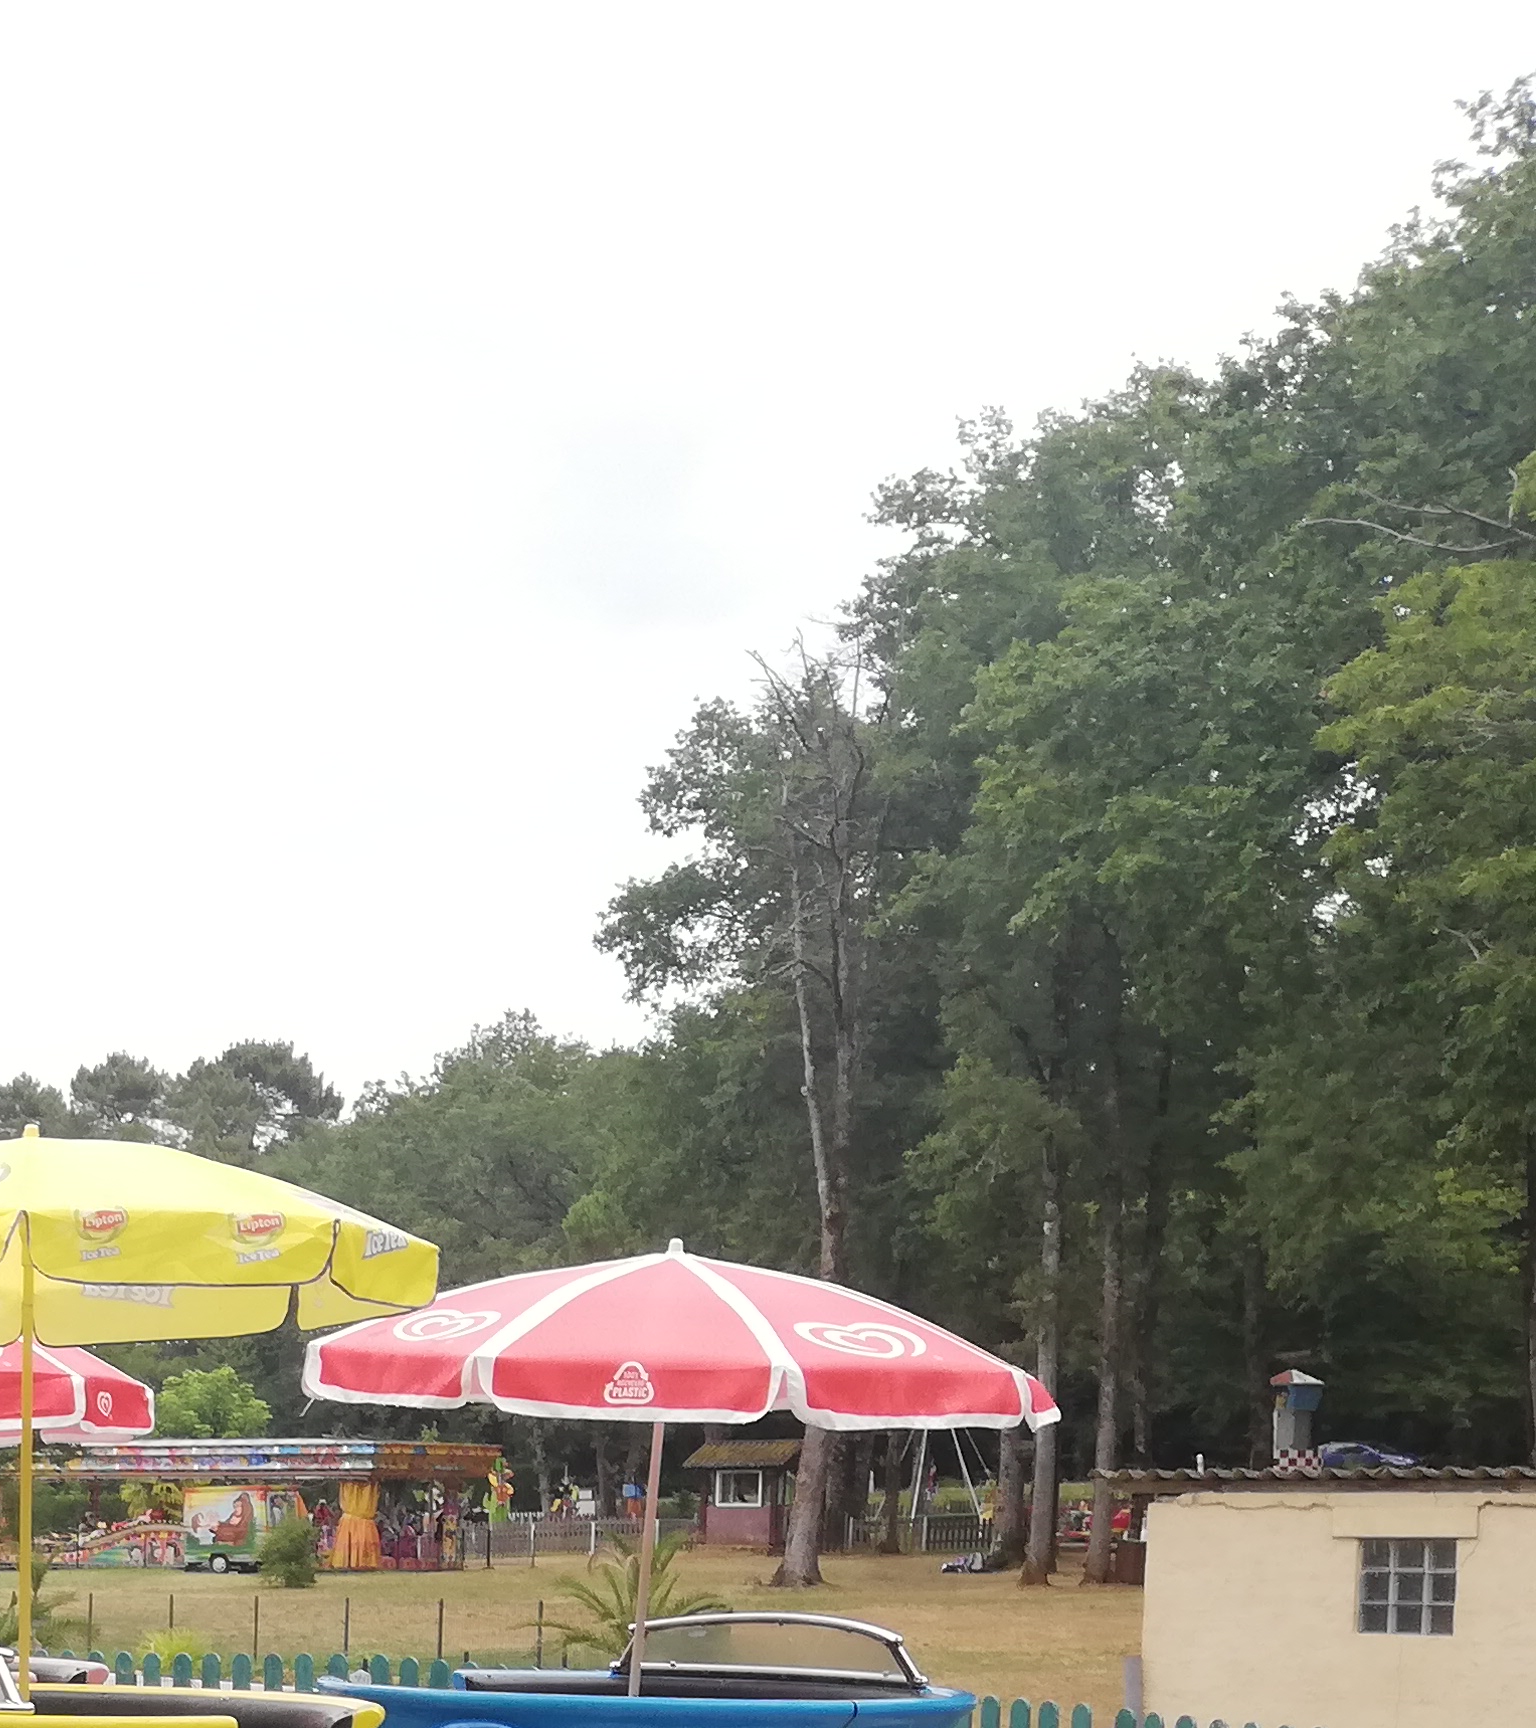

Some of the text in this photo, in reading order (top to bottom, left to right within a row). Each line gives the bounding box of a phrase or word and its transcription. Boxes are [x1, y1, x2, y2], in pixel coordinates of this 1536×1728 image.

[85, 1213, 123, 1229] Lipton
[239, 1217, 280, 1232] Lipton
[612, 1386, 648, 1398] PLASTIC
